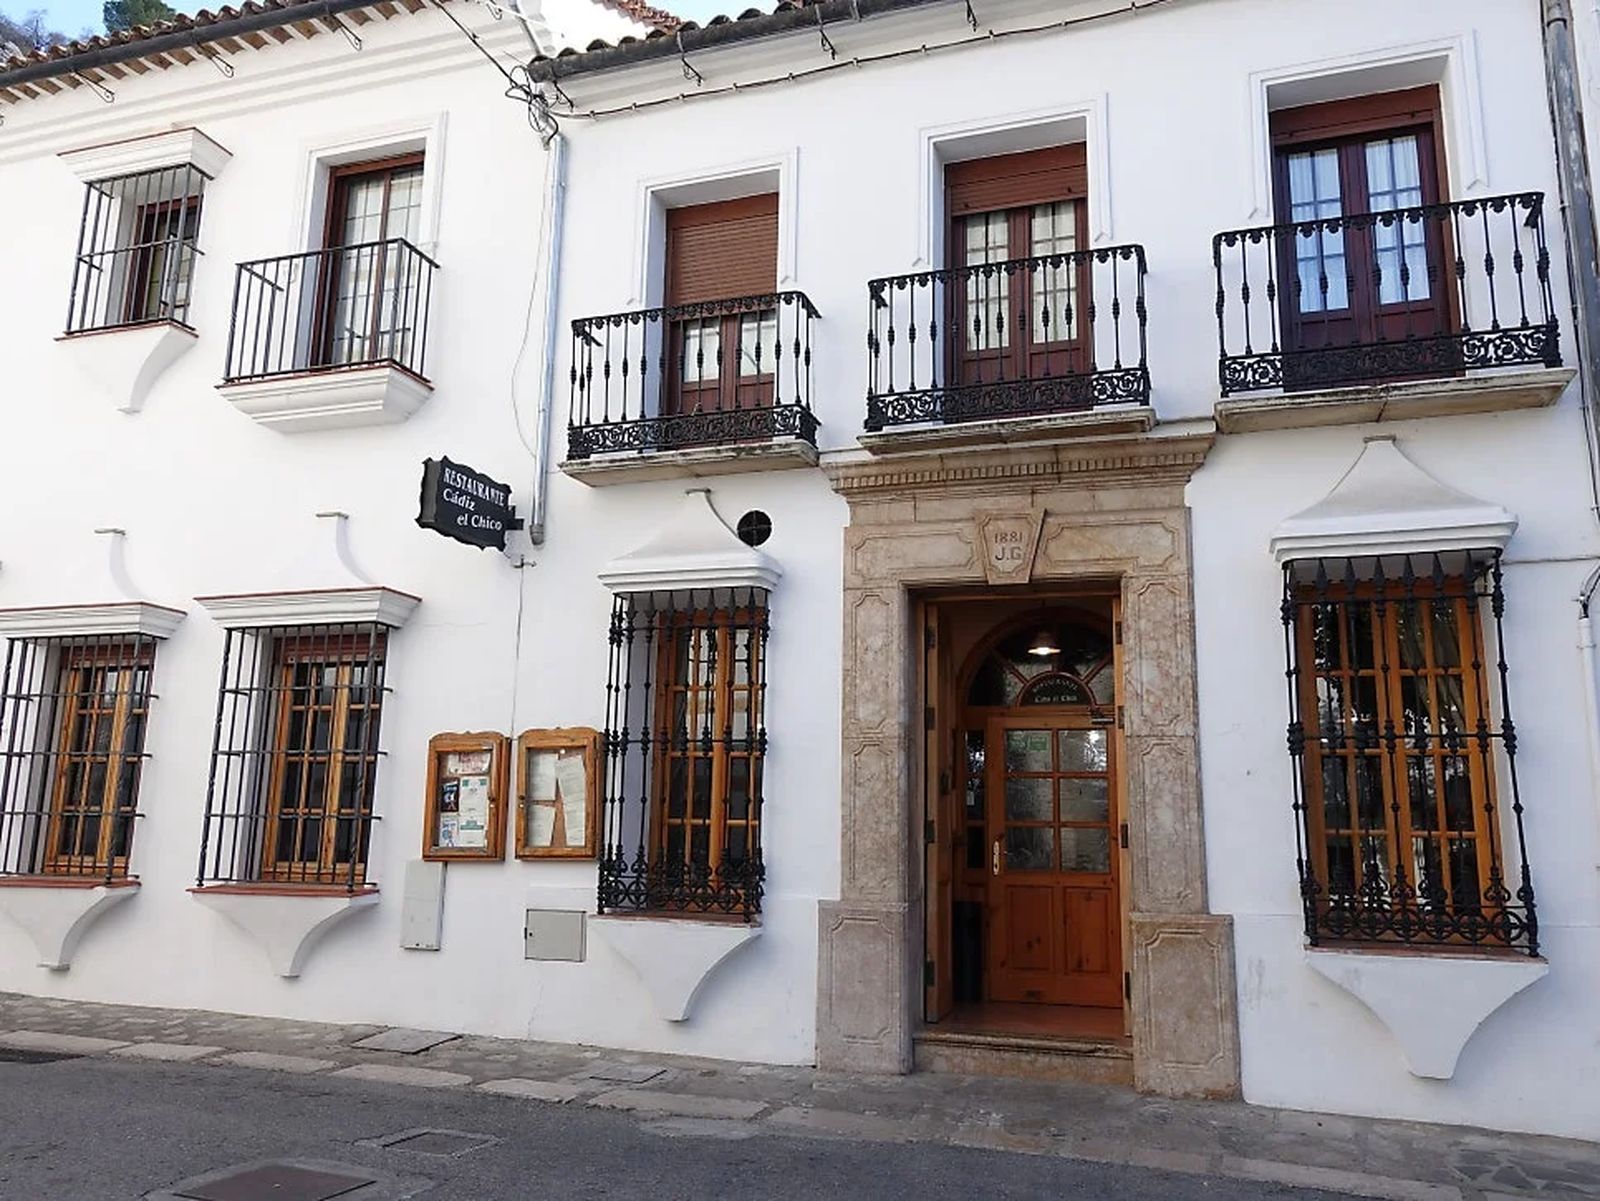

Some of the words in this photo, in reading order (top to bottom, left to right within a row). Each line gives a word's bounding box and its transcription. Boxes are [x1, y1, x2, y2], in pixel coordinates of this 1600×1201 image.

[443, 467, 505, 507] RESTAURANTE
[443, 488, 475, 511] Cádiz
[457, 513, 468, 526] el
[471, 514, 502, 531] Chico
[994, 531, 1023, 544] 1881
